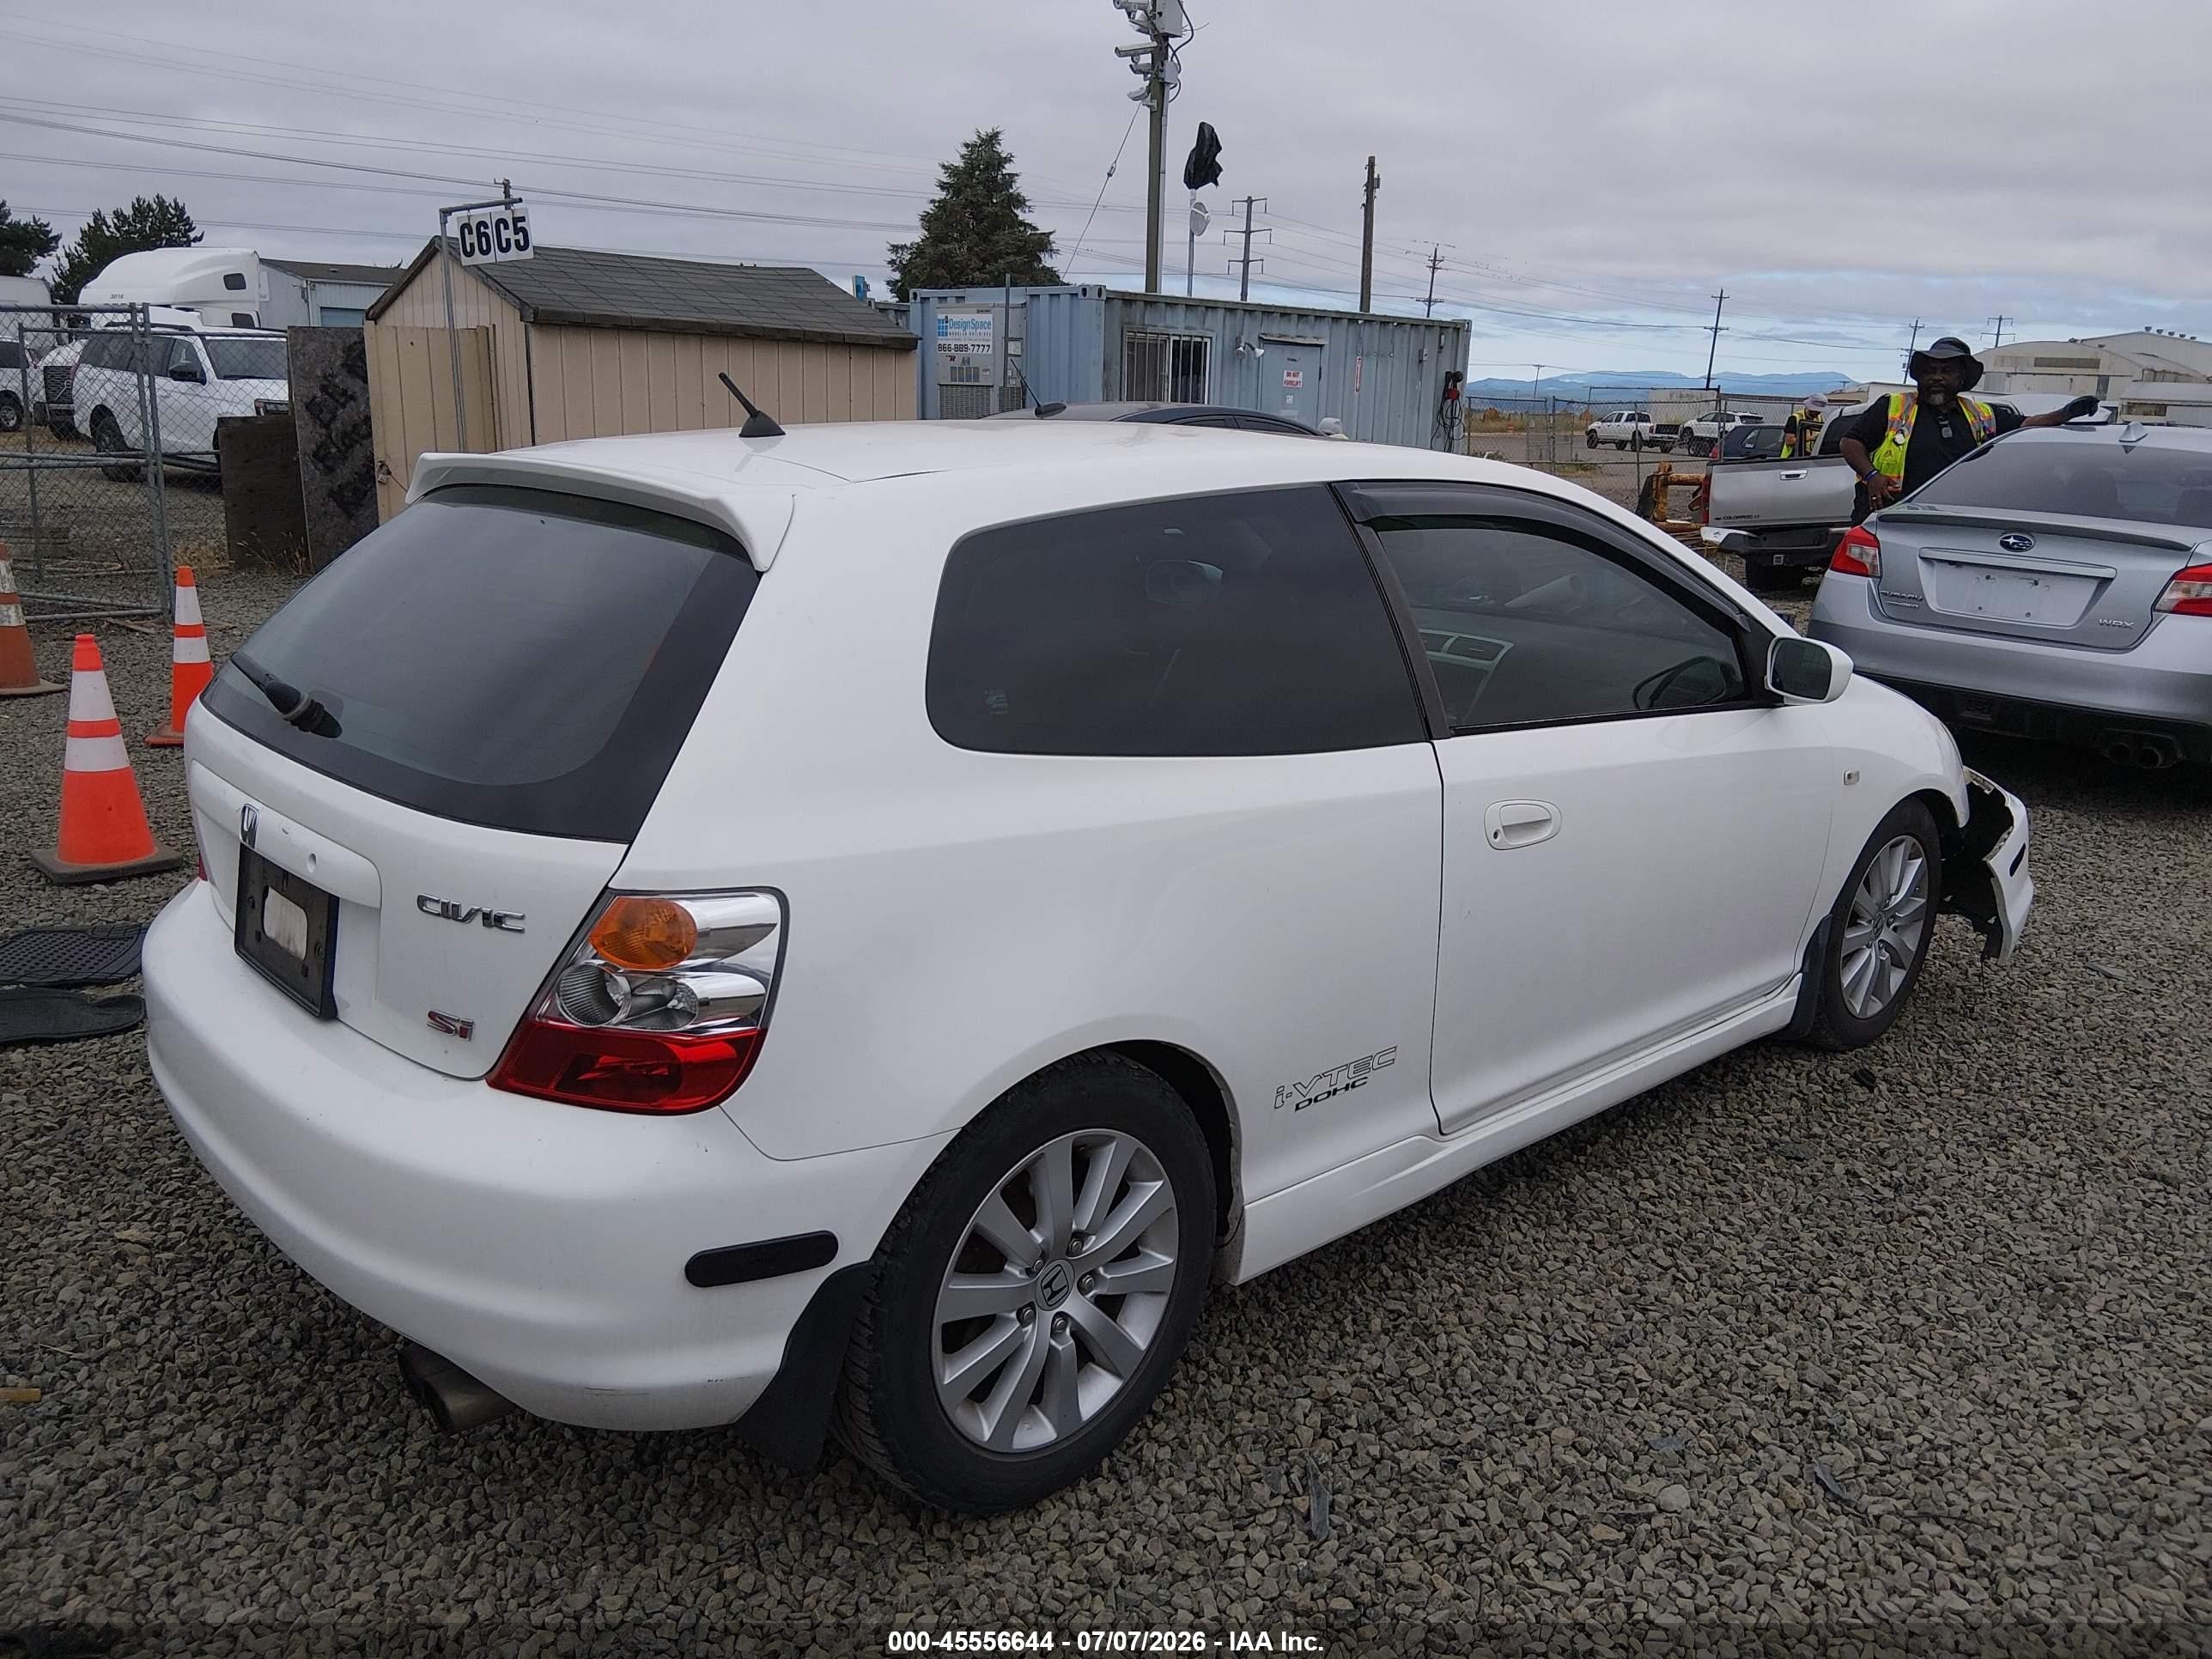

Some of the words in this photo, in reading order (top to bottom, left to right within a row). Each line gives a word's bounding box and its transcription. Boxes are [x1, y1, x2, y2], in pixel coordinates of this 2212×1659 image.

[459, 220, 492, 258] C6
[495, 216, 530, 254] C5
[949, 318, 992, 331] DesignSpace
[1880, 590, 1923, 601] SUBARU
[2098, 618, 2135, 629] WRX
[416, 892, 526, 934] CIVIC
[1273, 1045, 1399, 1109] i-VTEC
[1294, 1076, 1369, 1112] DOHC
